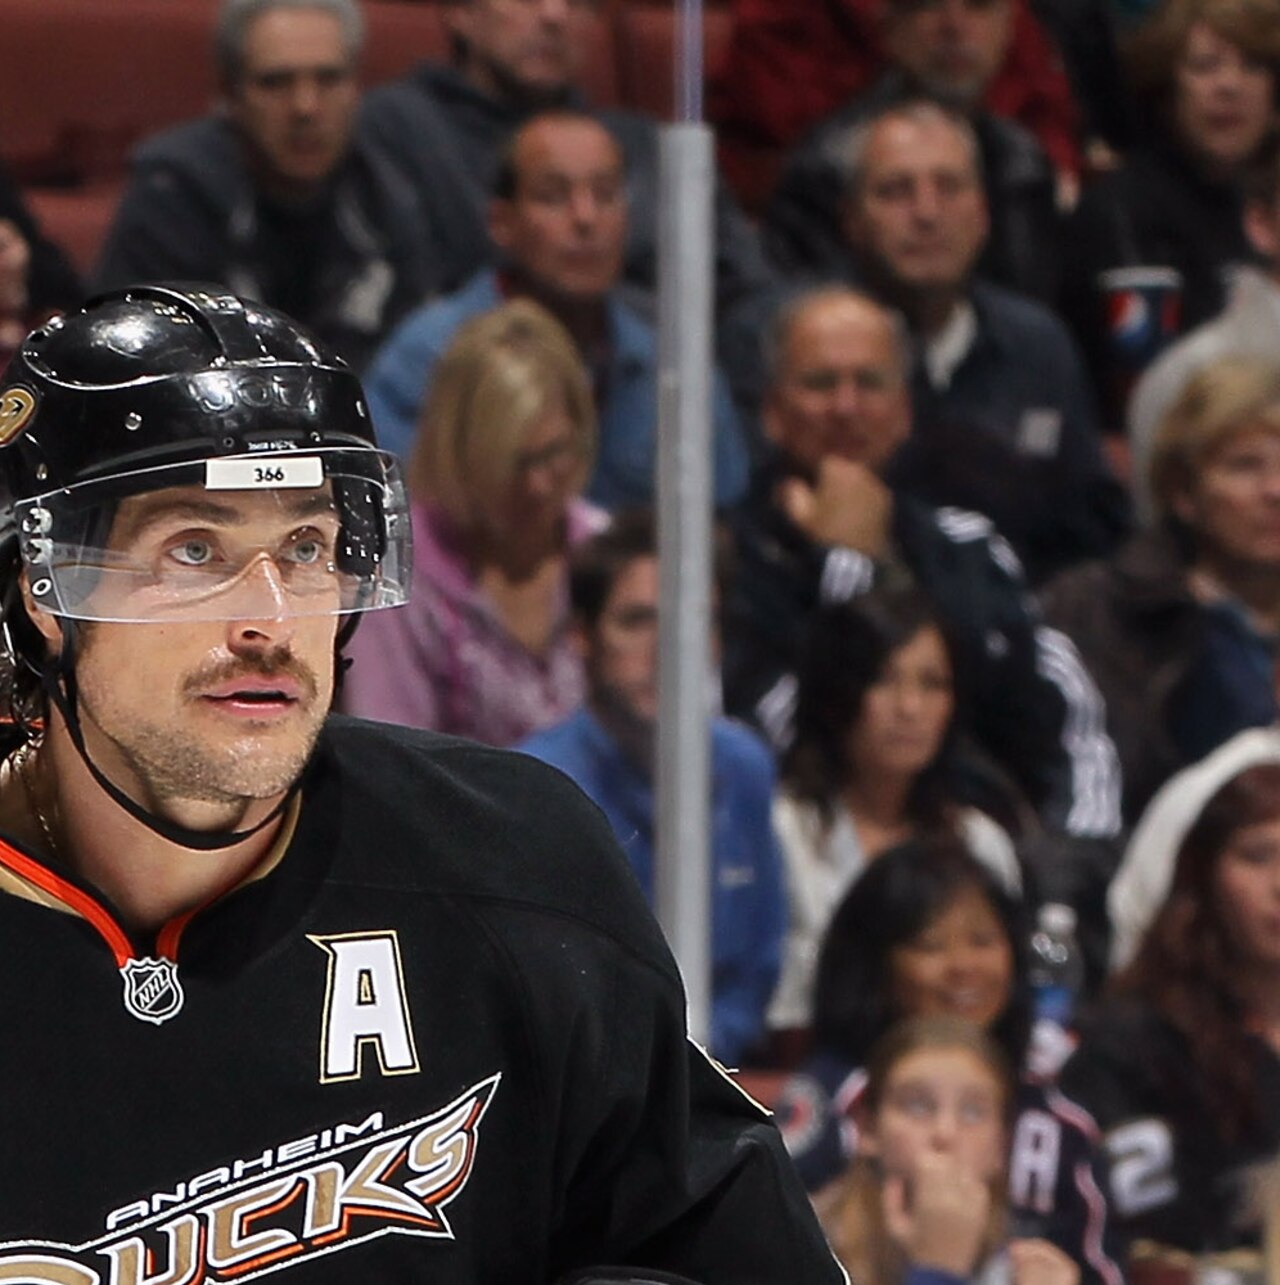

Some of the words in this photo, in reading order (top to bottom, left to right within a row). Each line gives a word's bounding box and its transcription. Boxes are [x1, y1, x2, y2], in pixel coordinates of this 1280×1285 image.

[254, 467, 284, 482] 366
[138, 972, 169, 1008] NHL
[312, 930, 420, 1083] A
[106, 1111, 383, 1230] ANAHEIM
